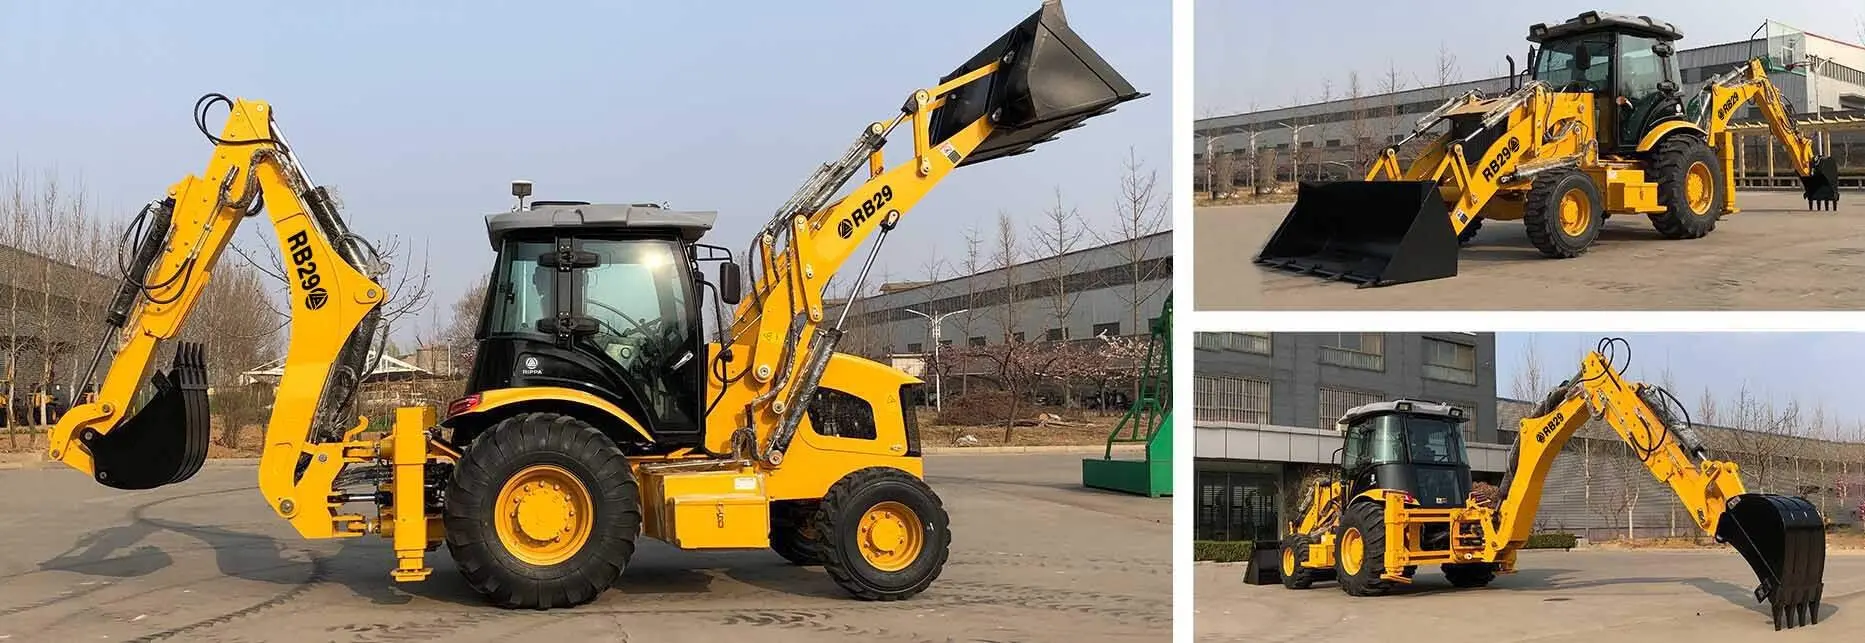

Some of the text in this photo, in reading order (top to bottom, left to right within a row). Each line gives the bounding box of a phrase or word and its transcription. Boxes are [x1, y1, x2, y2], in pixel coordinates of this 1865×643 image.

[1482, 147, 1511, 182] RB29
[851, 185, 893, 228] RB29
[287, 230, 321, 290] RB29
[1543, 413, 1564, 436] RB29
